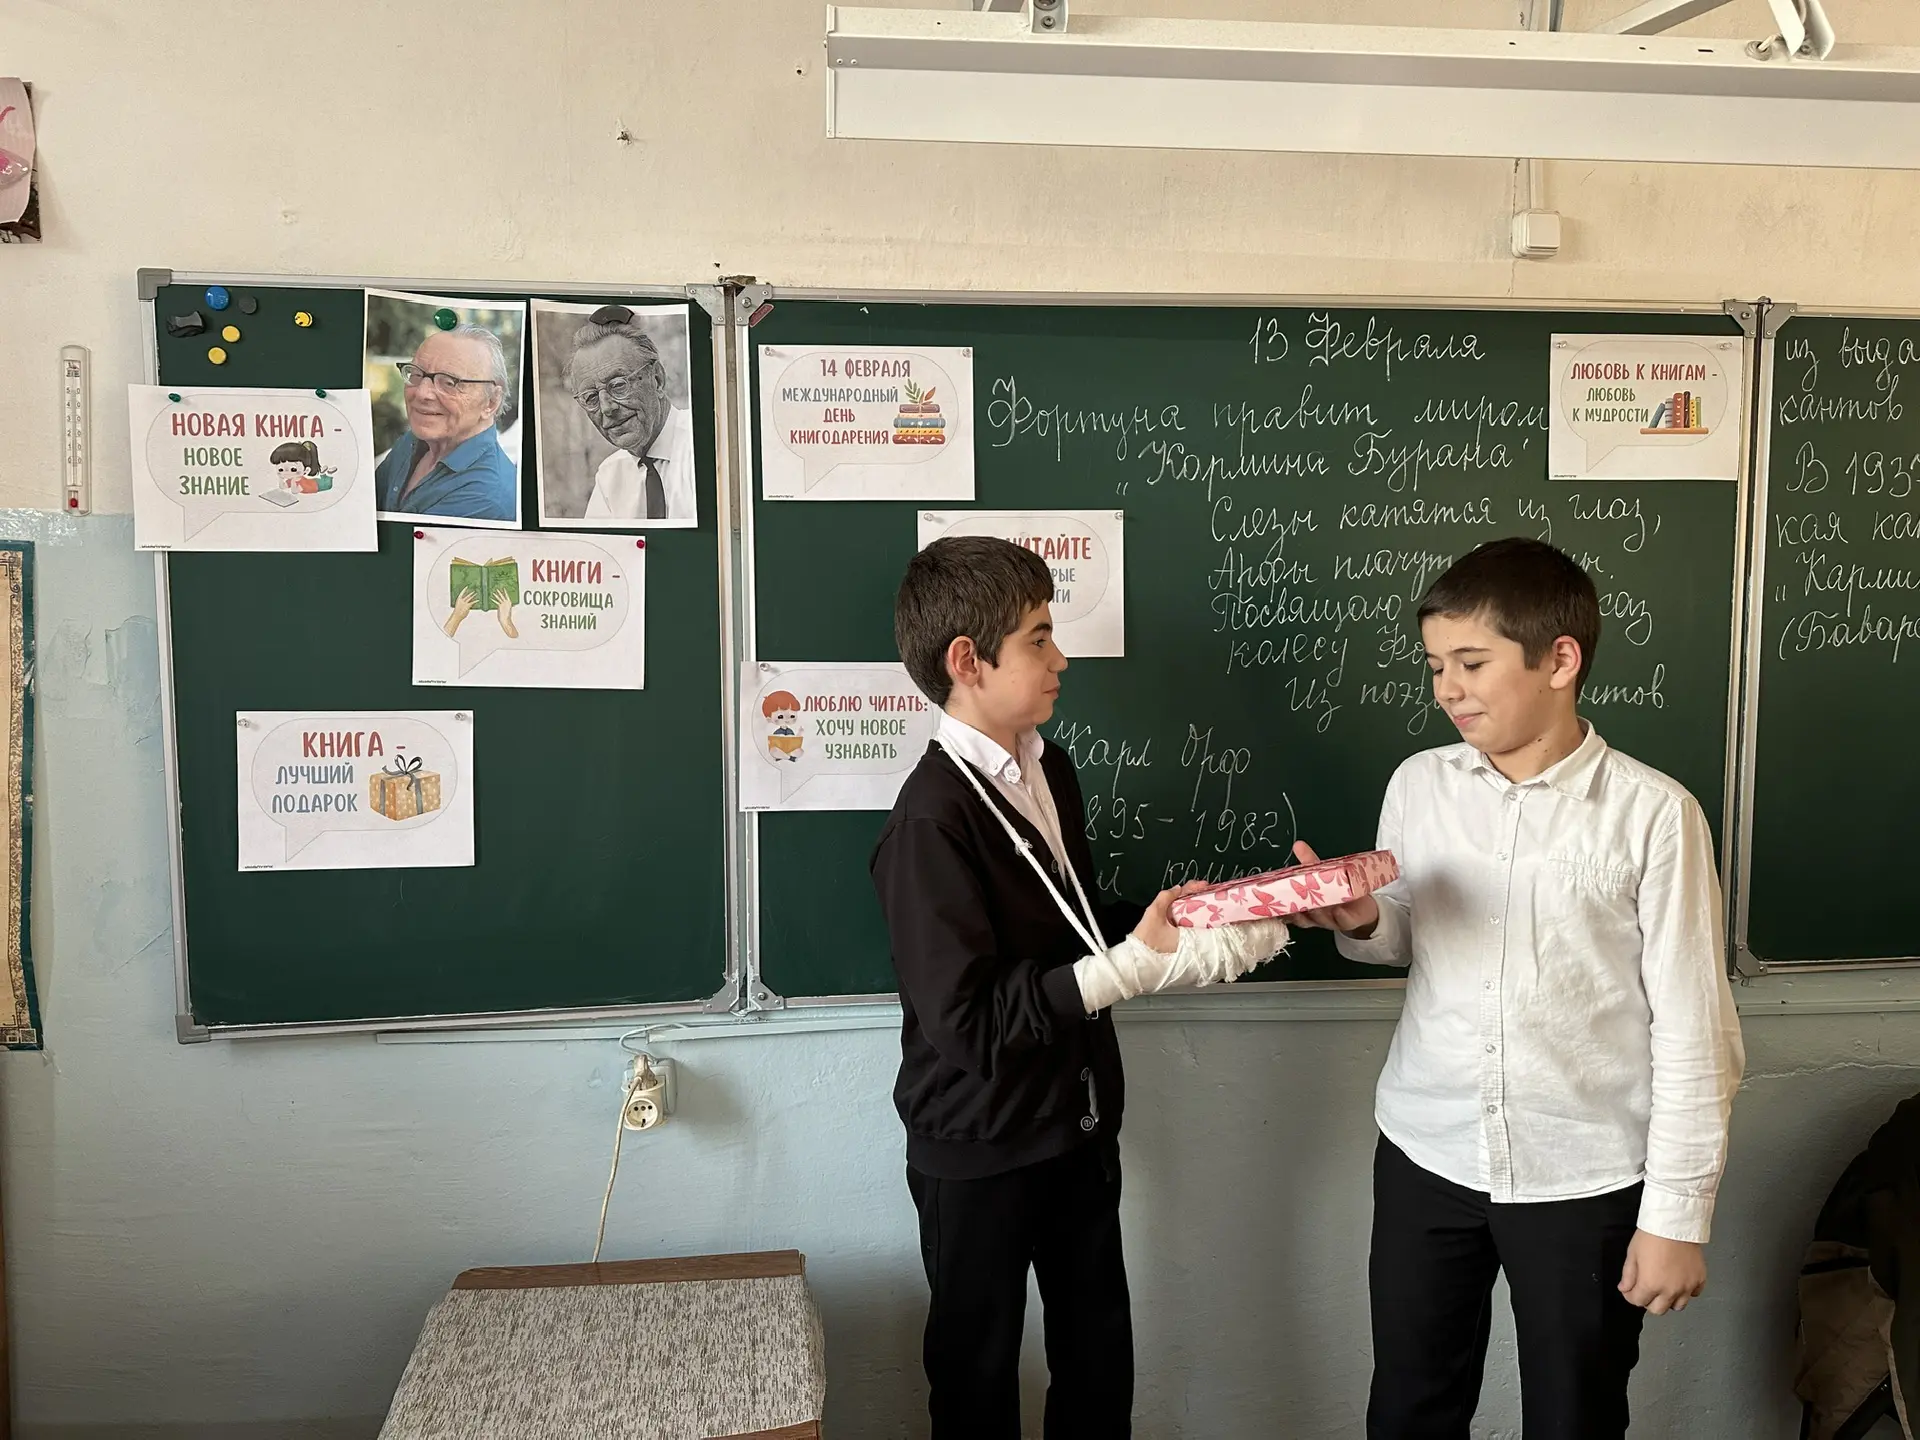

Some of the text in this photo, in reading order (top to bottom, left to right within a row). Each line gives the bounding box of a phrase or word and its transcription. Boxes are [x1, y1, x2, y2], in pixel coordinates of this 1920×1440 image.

[1249, 312, 1486, 382] 13 Февраля
[820, 358, 911, 379] 14 ФЕВРАЛЯ
[1786, 326, 1920, 392] из выда
[1570, 363, 1630, 380] ЛЮБОВЬ
[1636, 363, 1645, 380] К
[1651, 364, 1706, 381] КНИГАМ
[782, 386, 898, 403] МЕЖДУНАРОДНЫЙ
[1586, 387, 1636, 402] ЛЮБОВЬ
[1779, 374, 1904, 426] кантов
[172, 413, 245, 437] НОВАЯ
[255, 414, 324, 438] КНИГА
[823, 408, 856, 423] ДЕНЬ
[987, 375, 1549, 462] Фортуна правит миром
[1572, 408, 1649, 423] К МУДРОСТИ
[790, 429, 889, 445] КНИГОДАРЕНИЯ
[184, 447, 243, 467] НОВОЕ
[1786, 440, 1829, 494] В
[179, 475, 250, 496] ЗНАНИЕ
[1211, 495, 1319, 560] Слезы
[1339, 497, 1497, 530] катятся
[1518, 498, 1552, 545] из
[1775, 511, 1920, 548] кая ка
[532, 558, 602, 584] КНИГИ
[1051, 567, 1076, 582] РЫЕ
[1208, 547, 1319, 614] Арфы
[523, 590, 614, 611] СОКРОВИЩА
[1211, 588, 1401, 633] Посвящаю
[540, 613, 597, 630] ЗНАНИЙ
[1226, 633, 1348, 687] колесу
[803, 695, 928, 712] ЛЮБЛЮ ЧИТАТЬ:
[1285, 677, 1344, 733] Из
[816, 719, 907, 736] ХОЧУ НОВОЕ
[303, 731, 384, 758] КНИГА
[825, 743, 897, 760] УЗНАВАТЬ
[275, 761, 354, 785] ЛУЧШИЙ
[272, 793, 358, 814] ПОДАРОК
